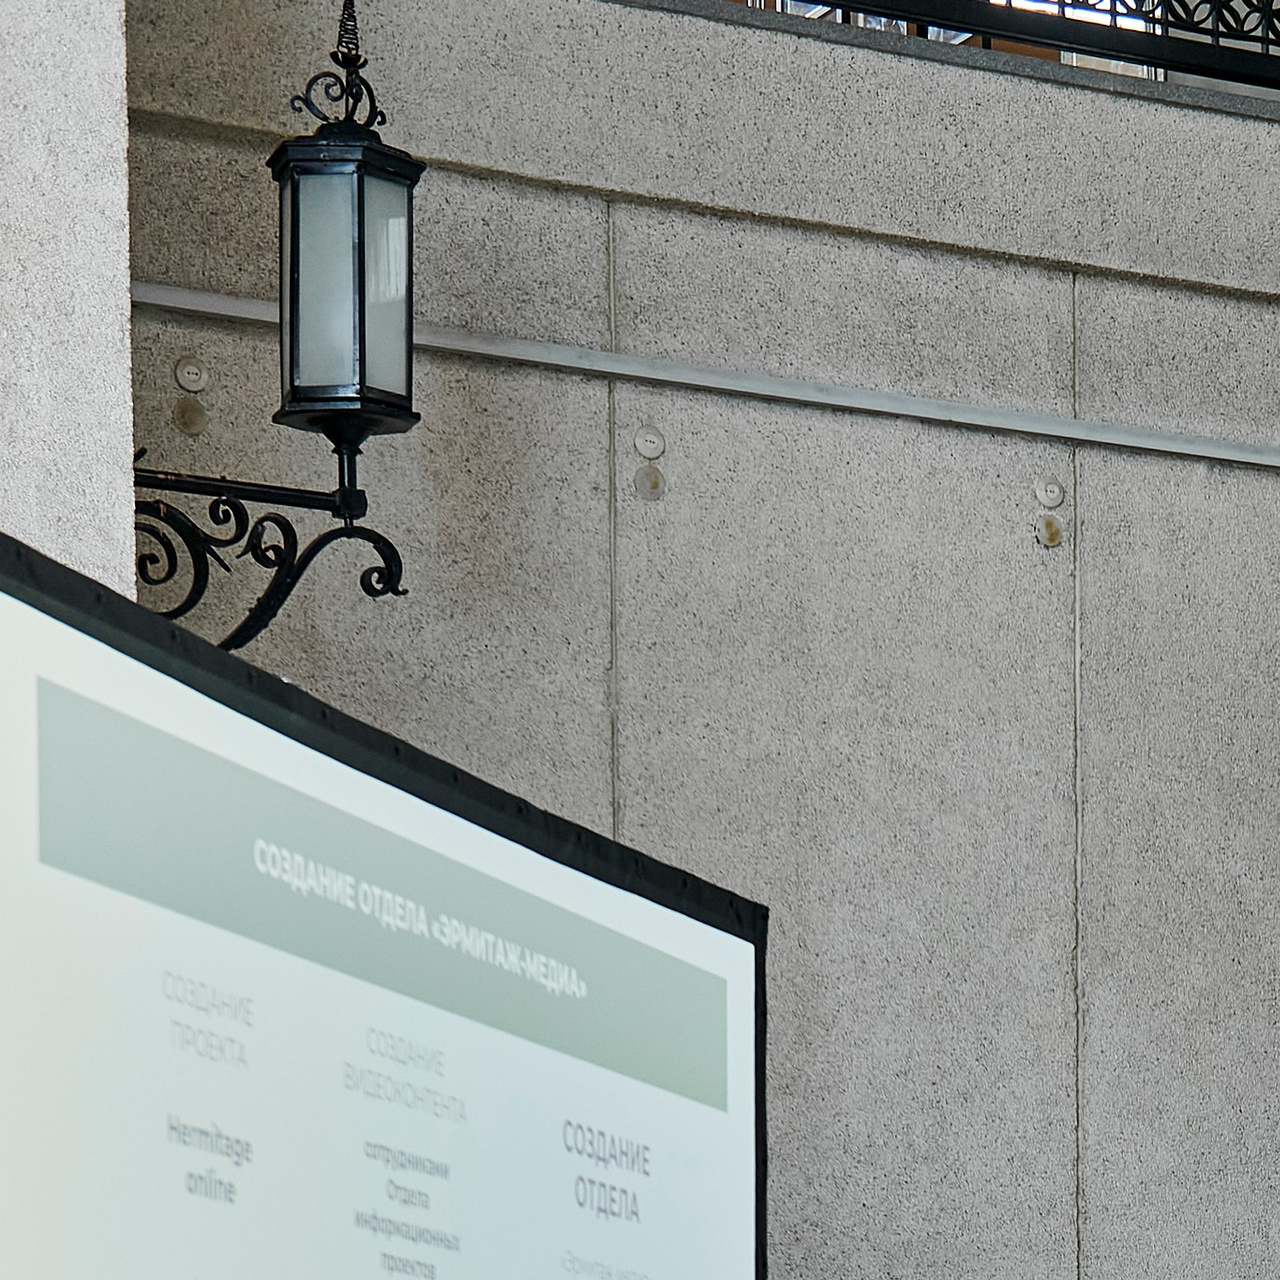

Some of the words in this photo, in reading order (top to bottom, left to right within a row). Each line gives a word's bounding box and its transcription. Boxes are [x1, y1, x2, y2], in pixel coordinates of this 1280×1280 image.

[253, 838, 356, 911] СОЗДАНИЕ
[358, 880, 430, 939] ОТДЕЛА
[167, 1112, 254, 1167] Hermitage
[563, 1118, 651, 1177] СОЗДАНИЕ
[184, 1168, 237, 1204] online
[574, 1175, 641, 1224] ОТДЕЛА
